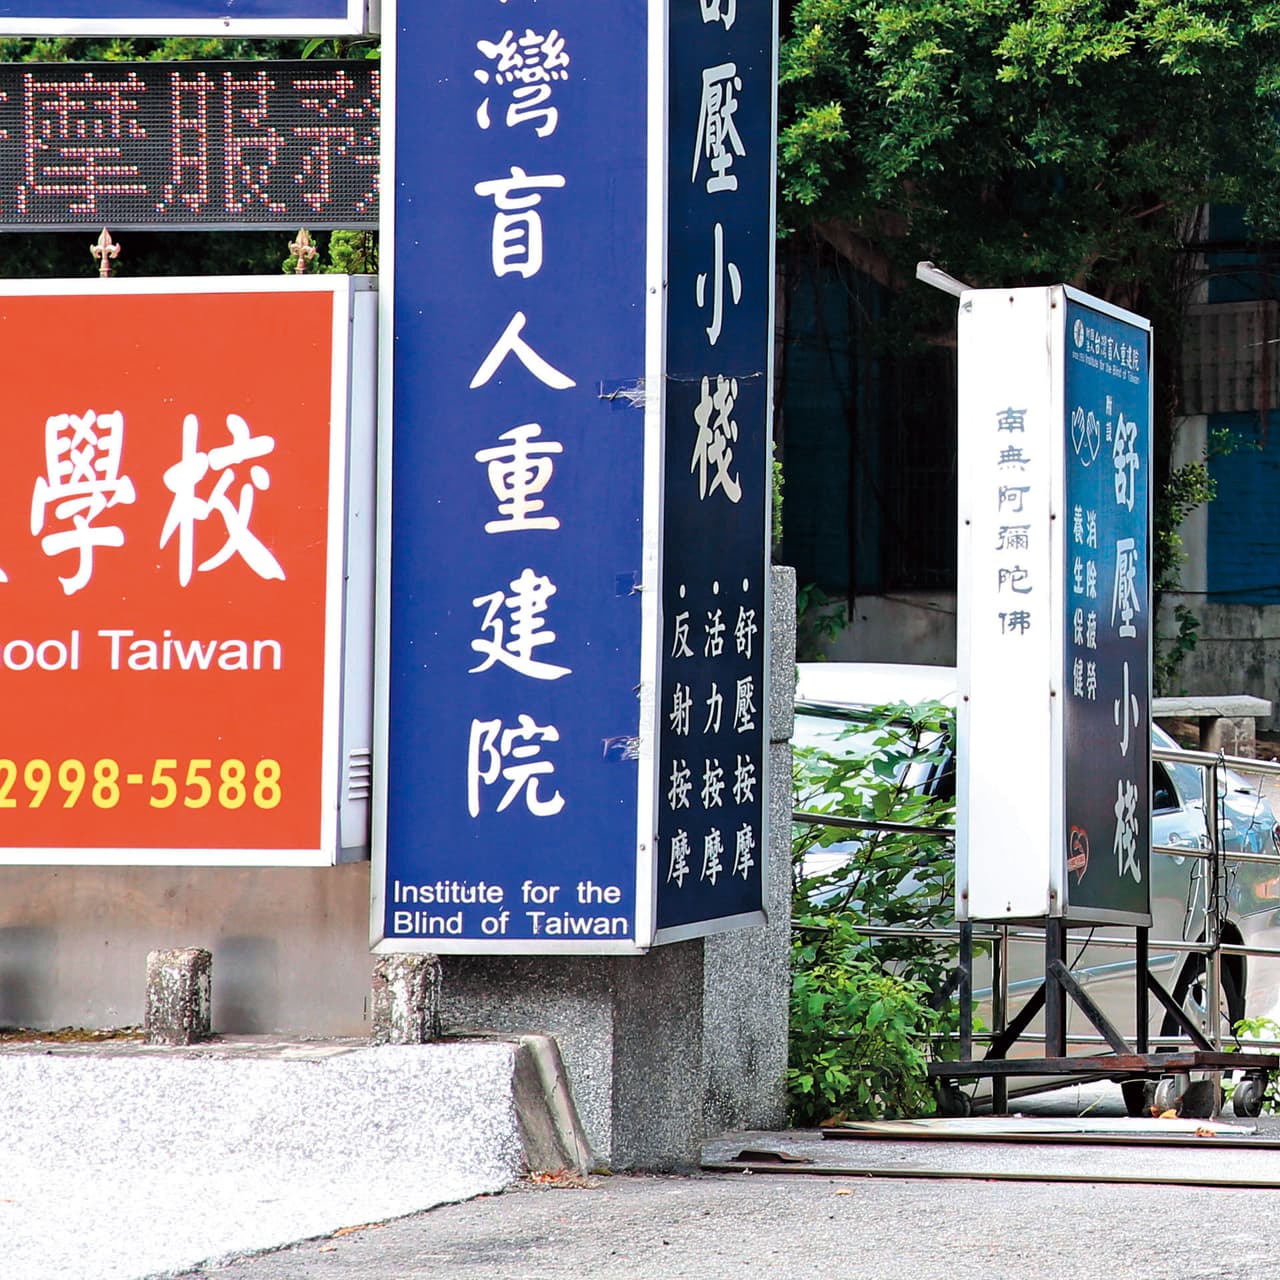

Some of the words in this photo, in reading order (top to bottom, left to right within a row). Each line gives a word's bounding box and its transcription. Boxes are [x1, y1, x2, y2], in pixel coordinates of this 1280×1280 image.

[0, 409, 287, 596] 學校
[995, 406, 1033, 635] 南無阿彌陀佛
[98, 630, 282, 671] Taiwan
[666, 612, 695, 888] 反射按摩
[700, 609, 726, 887] 活力按摩
[731, 605, 758, 881] 舒壓按摩
[1111, 412, 1141, 883] 舒壓小棧
[0, 758, 282, 809] 2998-5588
[393, 880, 504, 904] Institute
[521, 880, 560, 904] for
[577, 880, 621, 904] the
[393, 911, 463, 935] Blind
[481, 911, 510, 935] of
[526, 911, 629, 936] Taiwan
